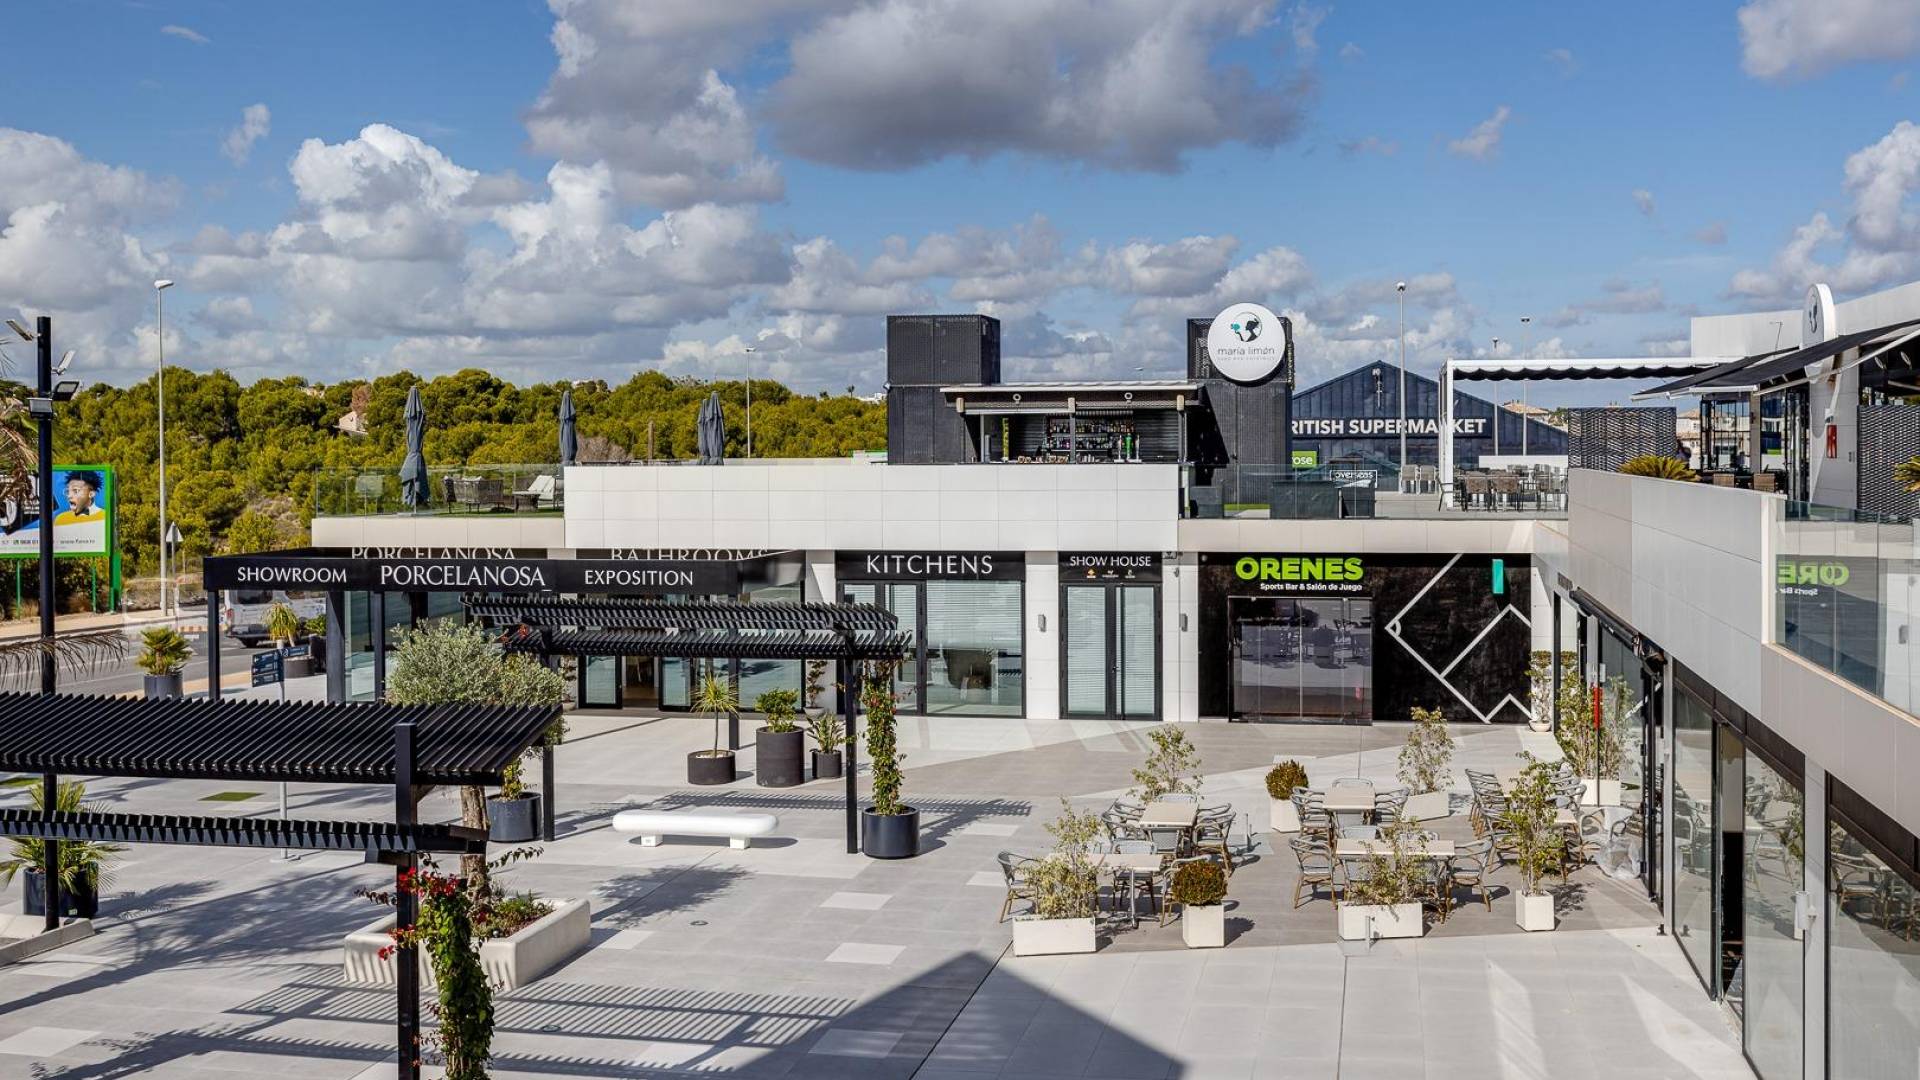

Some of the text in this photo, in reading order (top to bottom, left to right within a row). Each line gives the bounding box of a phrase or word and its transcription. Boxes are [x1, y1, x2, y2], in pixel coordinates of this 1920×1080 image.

[1348, 418, 1487, 435] SUPERMAKET
[1291, 456, 1313, 465] ose
[866, 554, 993, 574] KITCHENS
[1069, 555, 1152, 567] SHOW HOUSE
[1235, 556, 1364, 580] ORENES
[237, 565, 694, 586] SHOWROOM PORCELANOSA EXPOSITION
[1260, 583, 1284, 591] Sports
[1339, 583, 1362, 591] Juego
